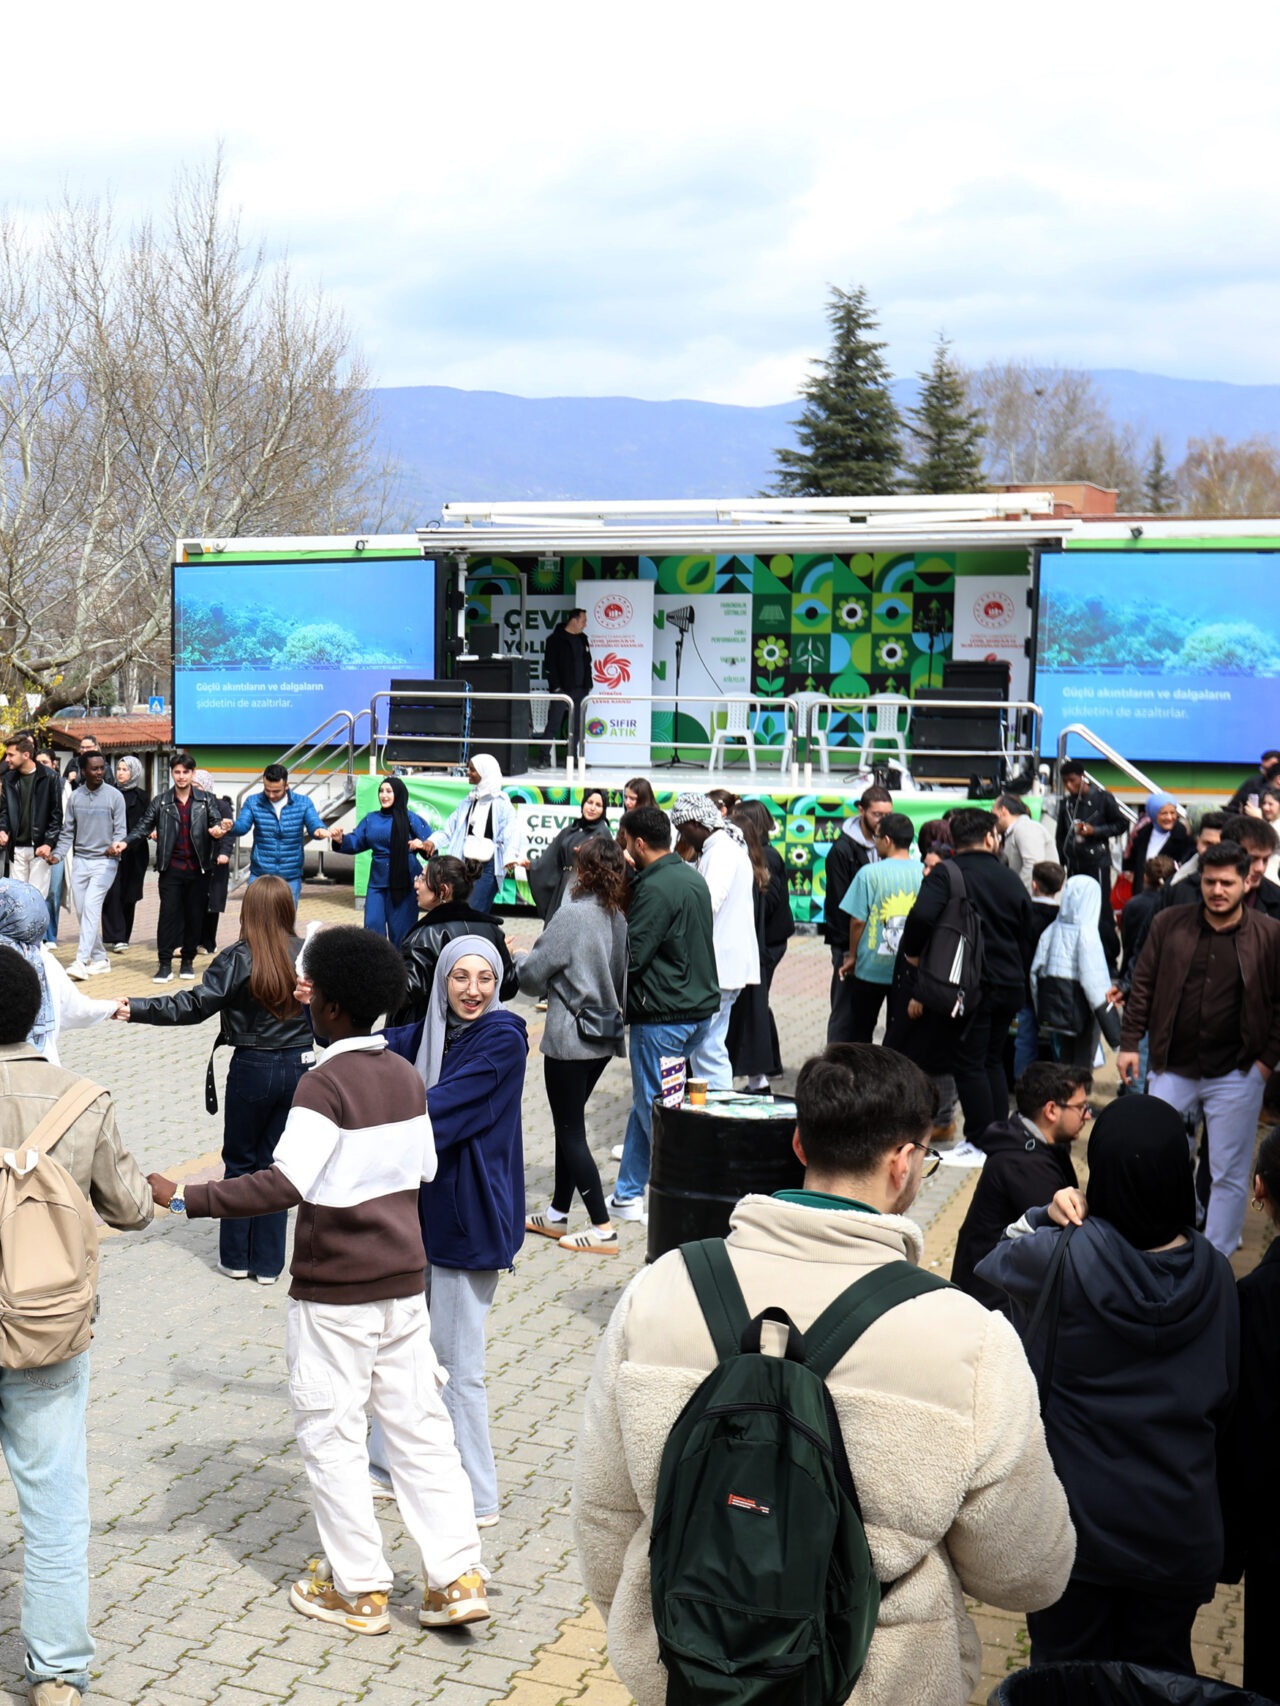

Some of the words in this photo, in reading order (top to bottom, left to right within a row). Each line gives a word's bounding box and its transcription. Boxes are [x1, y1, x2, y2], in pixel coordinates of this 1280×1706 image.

[196, 682, 220, 693] Güçlü
[280, 682, 324, 693] dalgaların
[1157, 690, 1170, 699] ve
[196, 698, 235, 710] şiddetini
[237, 698, 249, 708] de
[609, 719, 637, 727] SIFIR
[610, 728, 636, 737] ATIK
